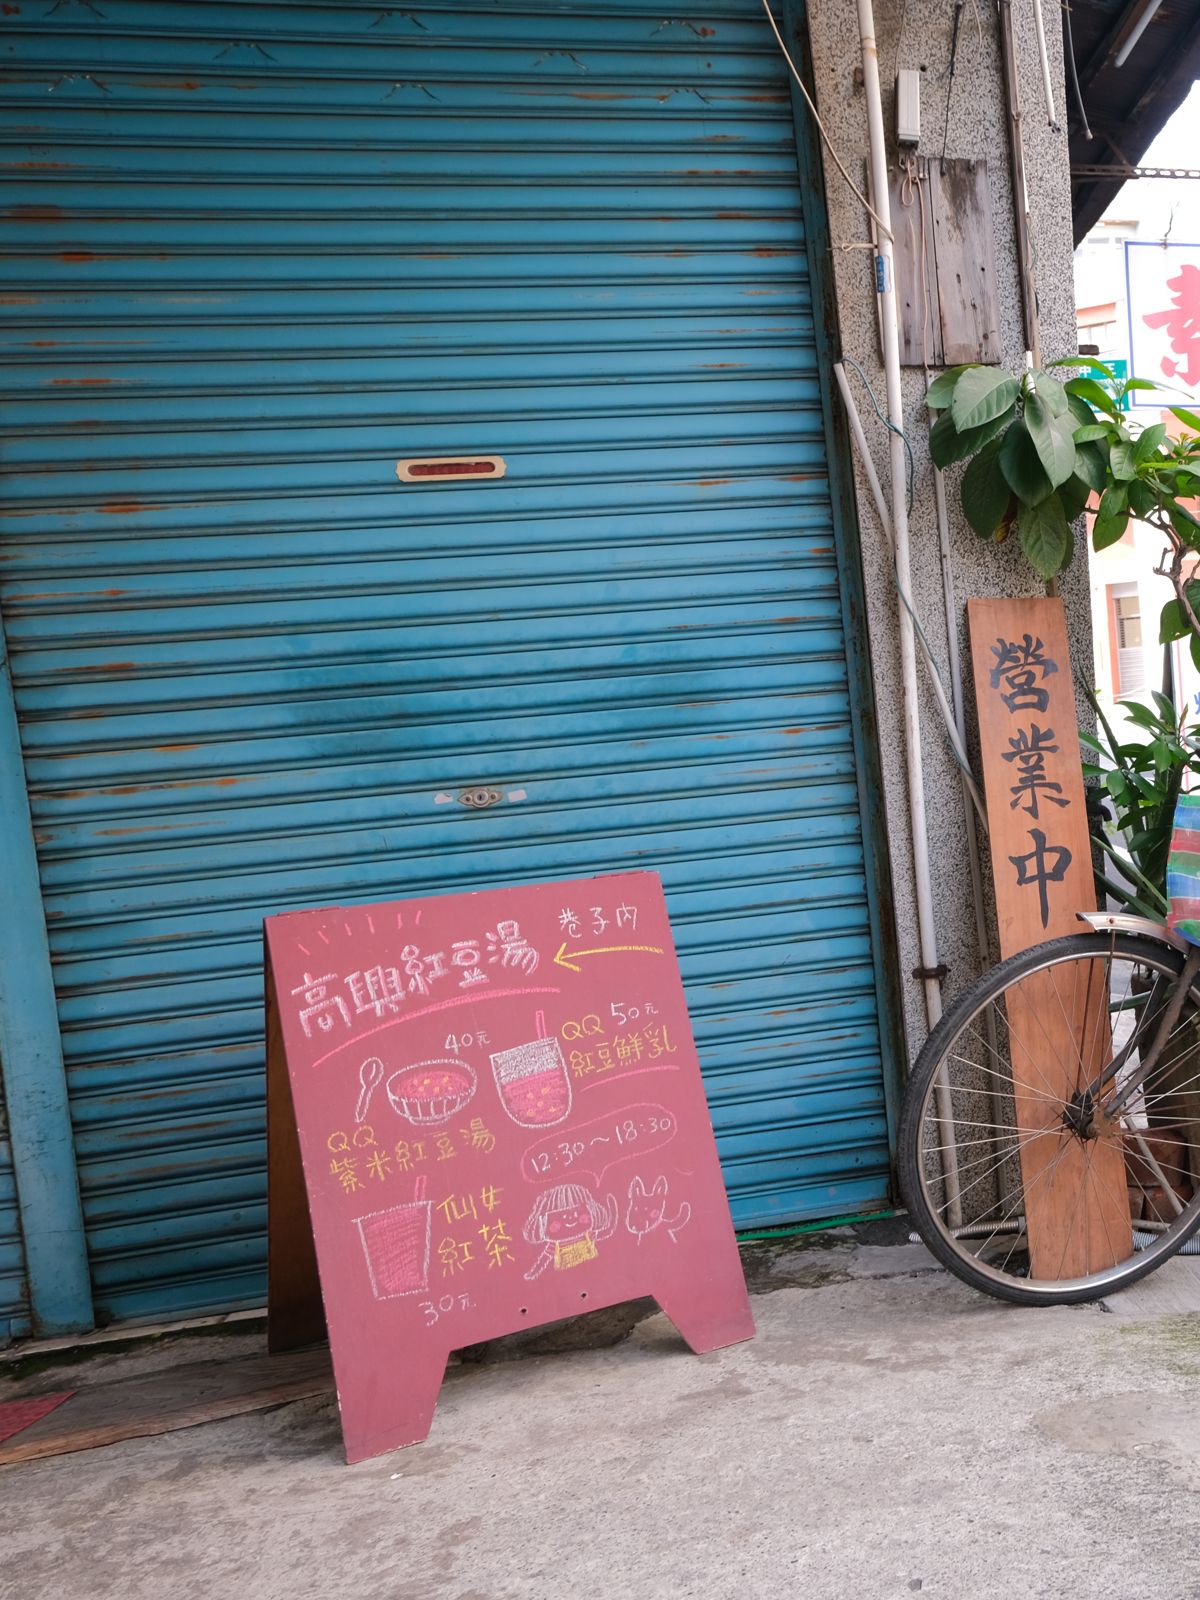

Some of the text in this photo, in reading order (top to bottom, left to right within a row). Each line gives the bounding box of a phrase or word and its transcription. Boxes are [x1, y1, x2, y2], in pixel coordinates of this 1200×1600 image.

[989, 633, 1072, 931] 營業中
[562, 1014, 605, 1041] QQ
[611, 1002, 660, 1026] 50元
[569, 1022, 678, 1078] 紅豆鮮乳
[327, 1126, 379, 1152] QQ
[329, 1117, 497, 1194] 紫米紅豆湯
[436, 1185, 505, 1224] 仙女
[437, 1218, 516, 1278] 紅茶
